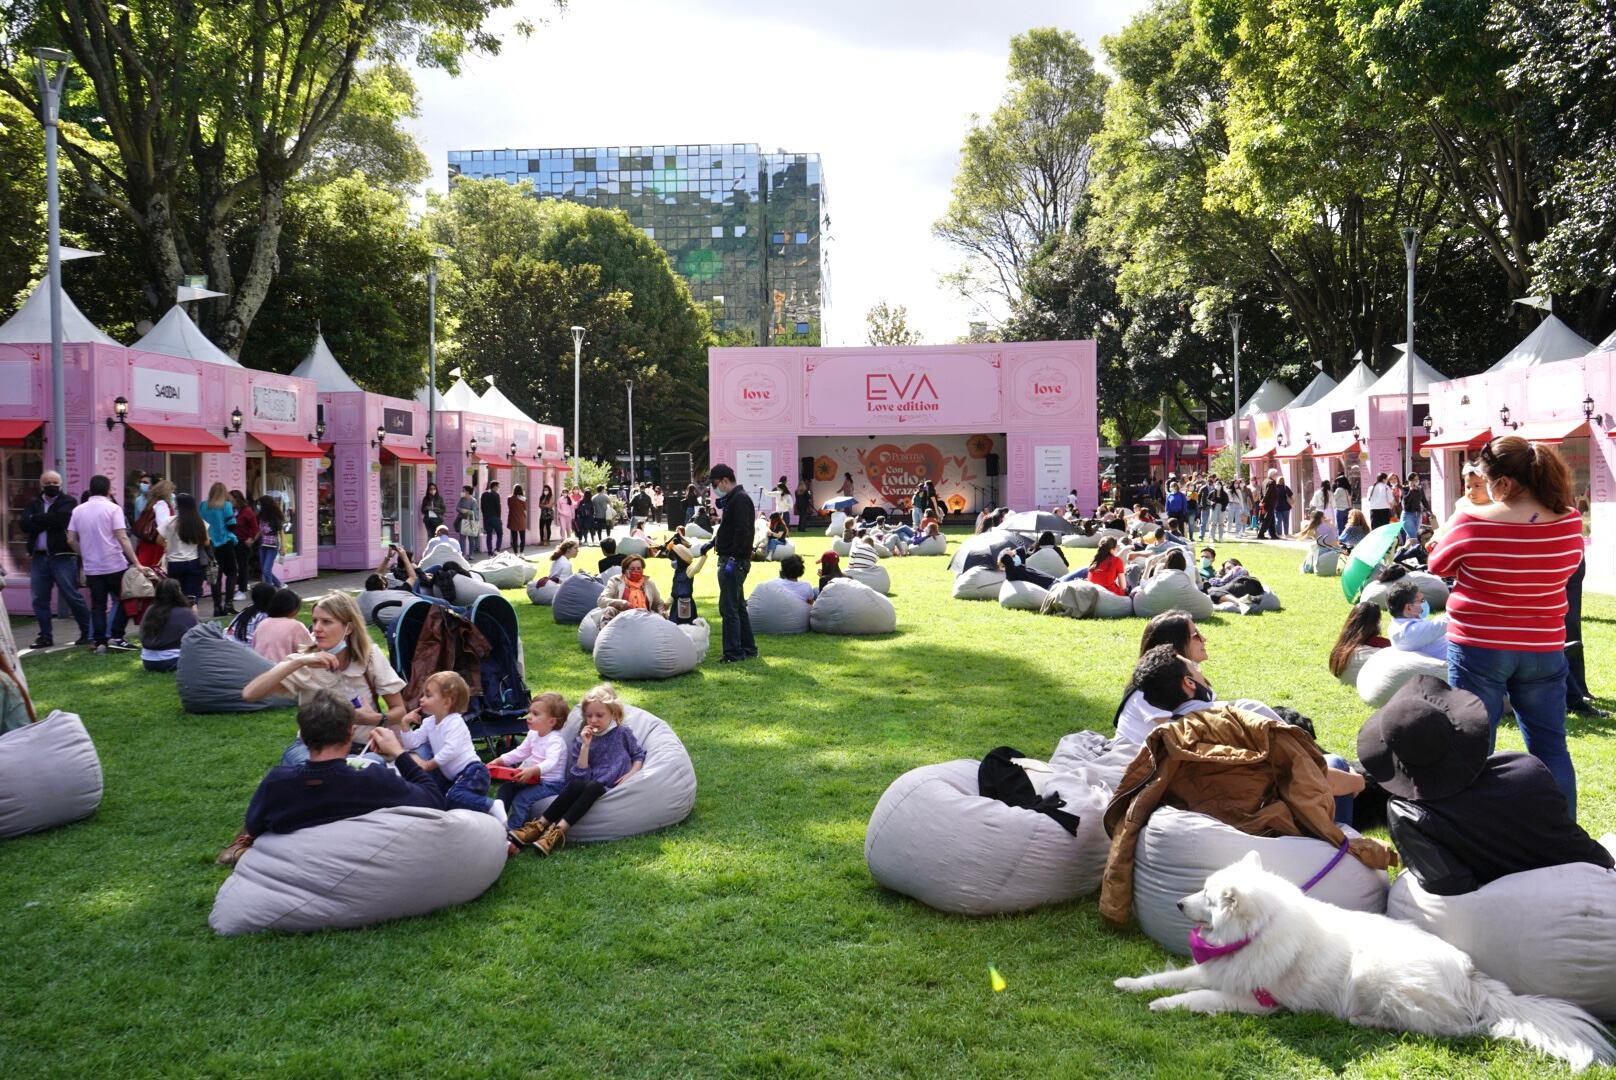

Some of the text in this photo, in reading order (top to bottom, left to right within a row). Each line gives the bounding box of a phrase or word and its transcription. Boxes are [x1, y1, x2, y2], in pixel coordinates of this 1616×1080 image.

[866, 373, 940, 400] EVA
[1034, 383, 1062, 394] love
[743, 388, 770, 399] love
[867, 401, 939, 412] Love edition
[886, 466, 904, 474] Con
[881, 472, 919, 486] todo
